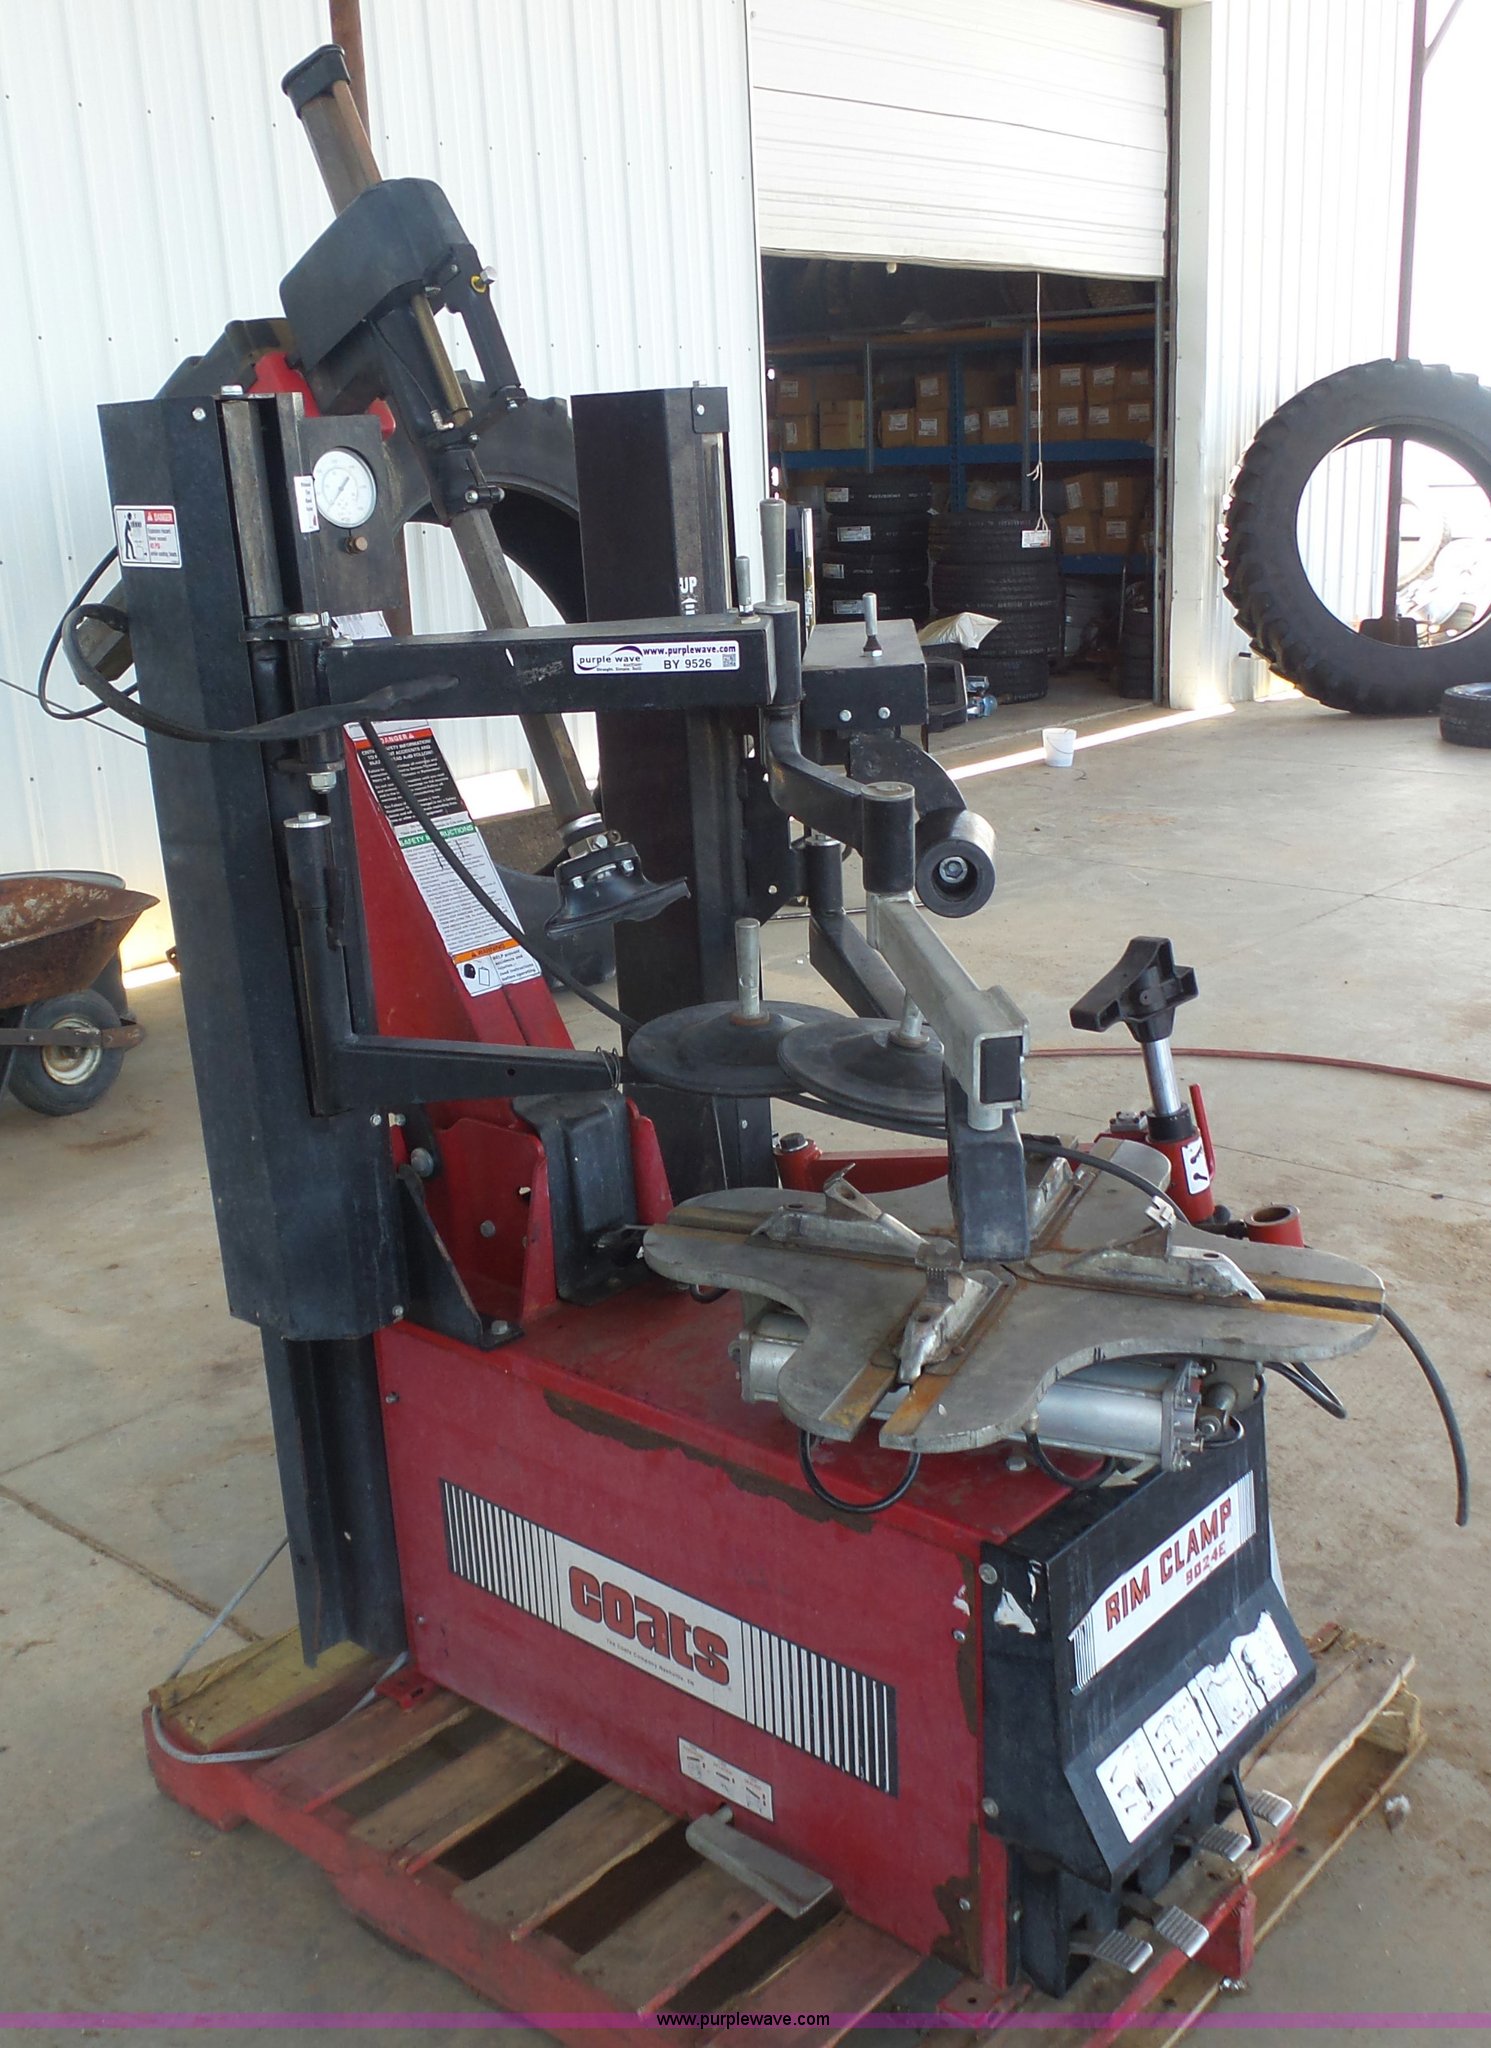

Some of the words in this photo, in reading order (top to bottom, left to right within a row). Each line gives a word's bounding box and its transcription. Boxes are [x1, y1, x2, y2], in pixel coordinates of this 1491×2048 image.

[679, 576, 697, 594] UP
[643, 645, 736, 657] www.purplewave.com
[579, 655, 612, 665] purple
[615, 655, 641, 663] wave
[664, 659, 680, 670] BY
[685, 658, 712, 669] 9526
[1105, 1565, 1151, 1632] RIM
[1159, 1497, 1232, 1585] CLAMP
